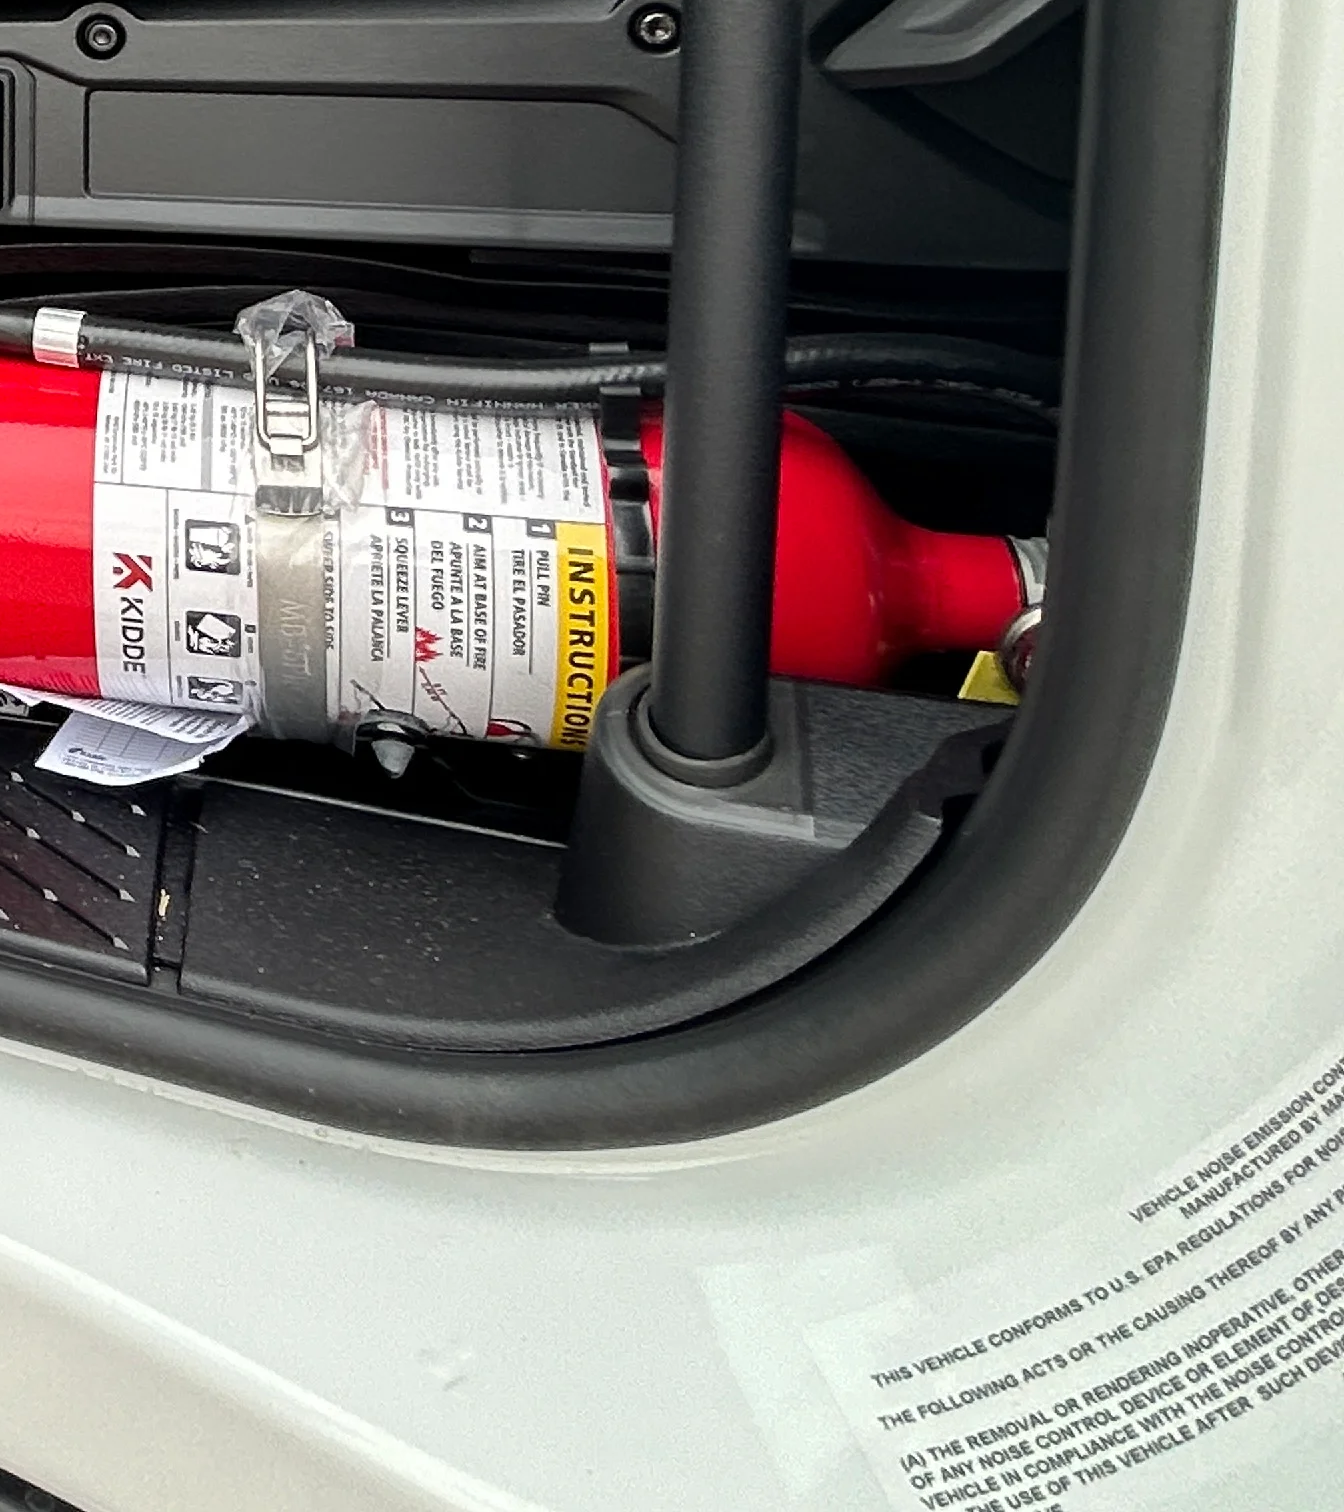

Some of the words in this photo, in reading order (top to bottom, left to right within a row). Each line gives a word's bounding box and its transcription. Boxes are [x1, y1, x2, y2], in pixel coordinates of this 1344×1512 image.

[123, 356, 163, 370] FIRE
[172, 364, 234, 378] LISTED
[365, 390, 435, 404] CANADA
[390, 510, 410, 523] 3
[468, 517, 488, 530] 2
[370, 534, 384, 588] APRIETE
[394, 537, 409, 593] SQUEEZE
[430, 540, 444, 564] DEL
[473, 544, 487, 570] AIM
[511, 549, 525, 575] TIRE
[536, 550, 550, 580] PULL
[449, 541, 463, 594] APUNTE
[473, 573, 487, 591] AT
[371, 590, 384, 606] LA
[431, 568, 445, 611] FUEGO
[451, 595, 463, 606] A
[512, 579, 526, 592] EL
[537, 585, 551, 607] PIN
[396, 596, 409, 634] LEVER
[450, 609, 463, 624] LA
[474, 594, 487, 625] BASE
[120, 597, 146, 674] KIDDE
[371, 609, 384, 662] PALANCA
[474, 629, 487, 646] OF
[512, 596, 527, 656] PASADOR
[450, 629, 463, 658] BASE
[561, 547, 595, 746] INSTRUCTIONS
[473, 647, 487, 671] FIRE
[1128, 1175, 1199, 1224] VEHICLE
[1196, 1144, 1247, 1183] NOISE
[1243, 1090, 1315, 1150] EMISSION
[1312, 1057, 1344, 1095] CON
[1179, 1129, 1303, 1219] MANUFACTURED
[1299, 1111, 1322, 1134] BY
[1321, 1085, 1344, 1117] MA
[870, 1366, 914, 1388] THIS
[912, 1339, 988, 1375] VEHICLE
[988, 1298, 1085, 1348] CONFORMS
[1083, 1286, 1109, 1305] TO
[1108, 1270, 1144, 1293] U.S.
[1142, 1250, 1179, 1276] EPA
[1177, 1180, 1285, 1256] REGULATIONS
[1283, 1155, 1319, 1185] FOR
[877, 1408, 917, 1431] THE
[916, 1374, 1019, 1419] FOLLOWING
[1021, 1354, 1068, 1383] ACTS
[1068, 1341, 1097, 1362] OR
[1095, 1323, 1134, 1349] THE
[1132, 1285, 1206, 1331] CAUSING
[1205, 1237, 1279, 1290] THEREOF
[1279, 1221, 1303, 1244] BY
[1302, 1197, 1336, 1229] ANY
[899, 1451, 928, 1474] (A)
[927, 1439, 966, 1462] THE
[964, 1410, 1053, 1450] REMOVAL
[1053, 1397, 1083, 1418] OR
[1081, 1350, 1182, 1407] RENDERING
[1293, 1249, 1344, 1292] OTHER
[909, 1471, 936, 1490] OF
[940, 1459, 976, 1483] ANY
[977, 1439, 1034, 1470] NOISE
[1035, 1408, 1121, 1449] CONTROL
[1118, 1374, 1187, 1415] DEVICE
[1185, 1361, 1214, 1383] OR
[1211, 1315, 1291, 1369] ELEMENT
[1315, 1272, 1344, 1306] DES
[919, 1476, 1002, 1511] VEHICLE
[1000, 1469, 1023, 1487] IN
[1023, 1423, 1140, 1479] COMPLIANCE
[1136, 1402, 1187, 1433] WITH
[1185, 1382, 1226, 1409] THE
[1222, 1353, 1277, 1392] NOISE
[1004, 1485, 1047, 1509] USE
[1047, 1475, 1071, 1496] OF
[1072, 1459, 1118, 1485] THIS
[1116, 1424, 1196, 1468] VEHICLE
[1195, 1396, 1254, 1434] AFTER
[1257, 1365, 1307, 1401] SUCH
